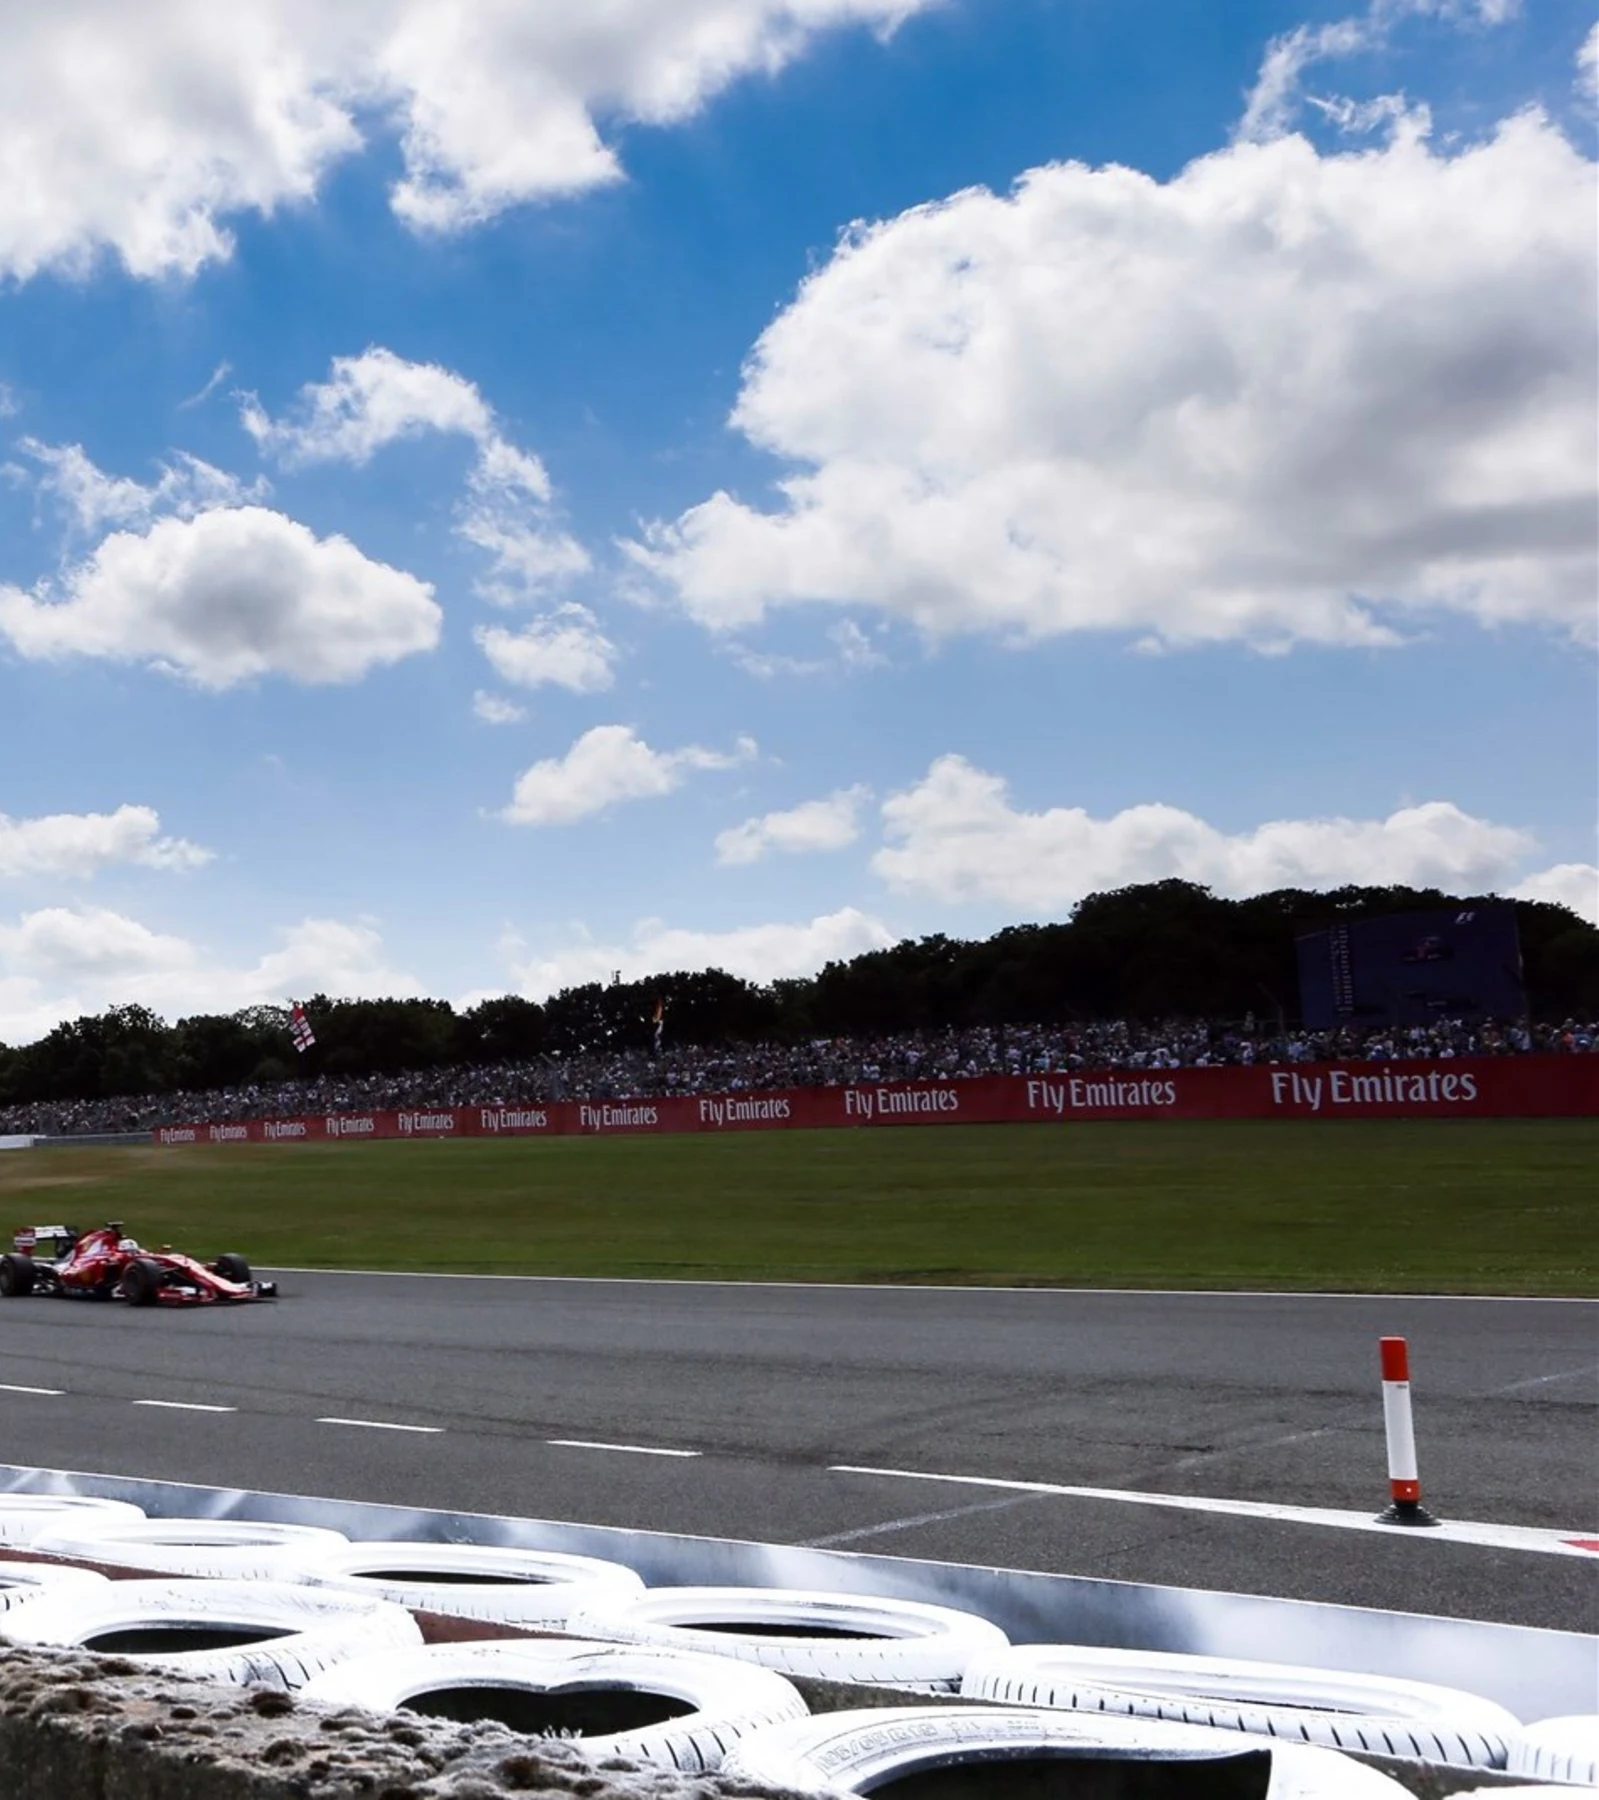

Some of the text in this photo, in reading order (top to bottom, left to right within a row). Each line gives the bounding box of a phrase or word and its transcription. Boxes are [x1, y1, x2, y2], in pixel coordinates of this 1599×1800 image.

[1027, 1076, 1175, 1113] Fly Emirates
[1271, 1067, 1477, 1110] Fly Emirates
[700, 1096, 790, 1125] Fly Emirates
[845, 1086, 959, 1119] Fly Emirates
[327, 1115, 374, 1136] Fly Emirates
[399, 1111, 453, 1133] Fly Emirates
[481, 1107, 547, 1131] Fly Emirates
[580, 1103, 658, 1130] Fly Emirates
[160, 1127, 195, 1144] Fly Emirates
[210, 1124, 247, 1142] Fly Emirates
[264, 1120, 306, 1139] Fly Emirates
